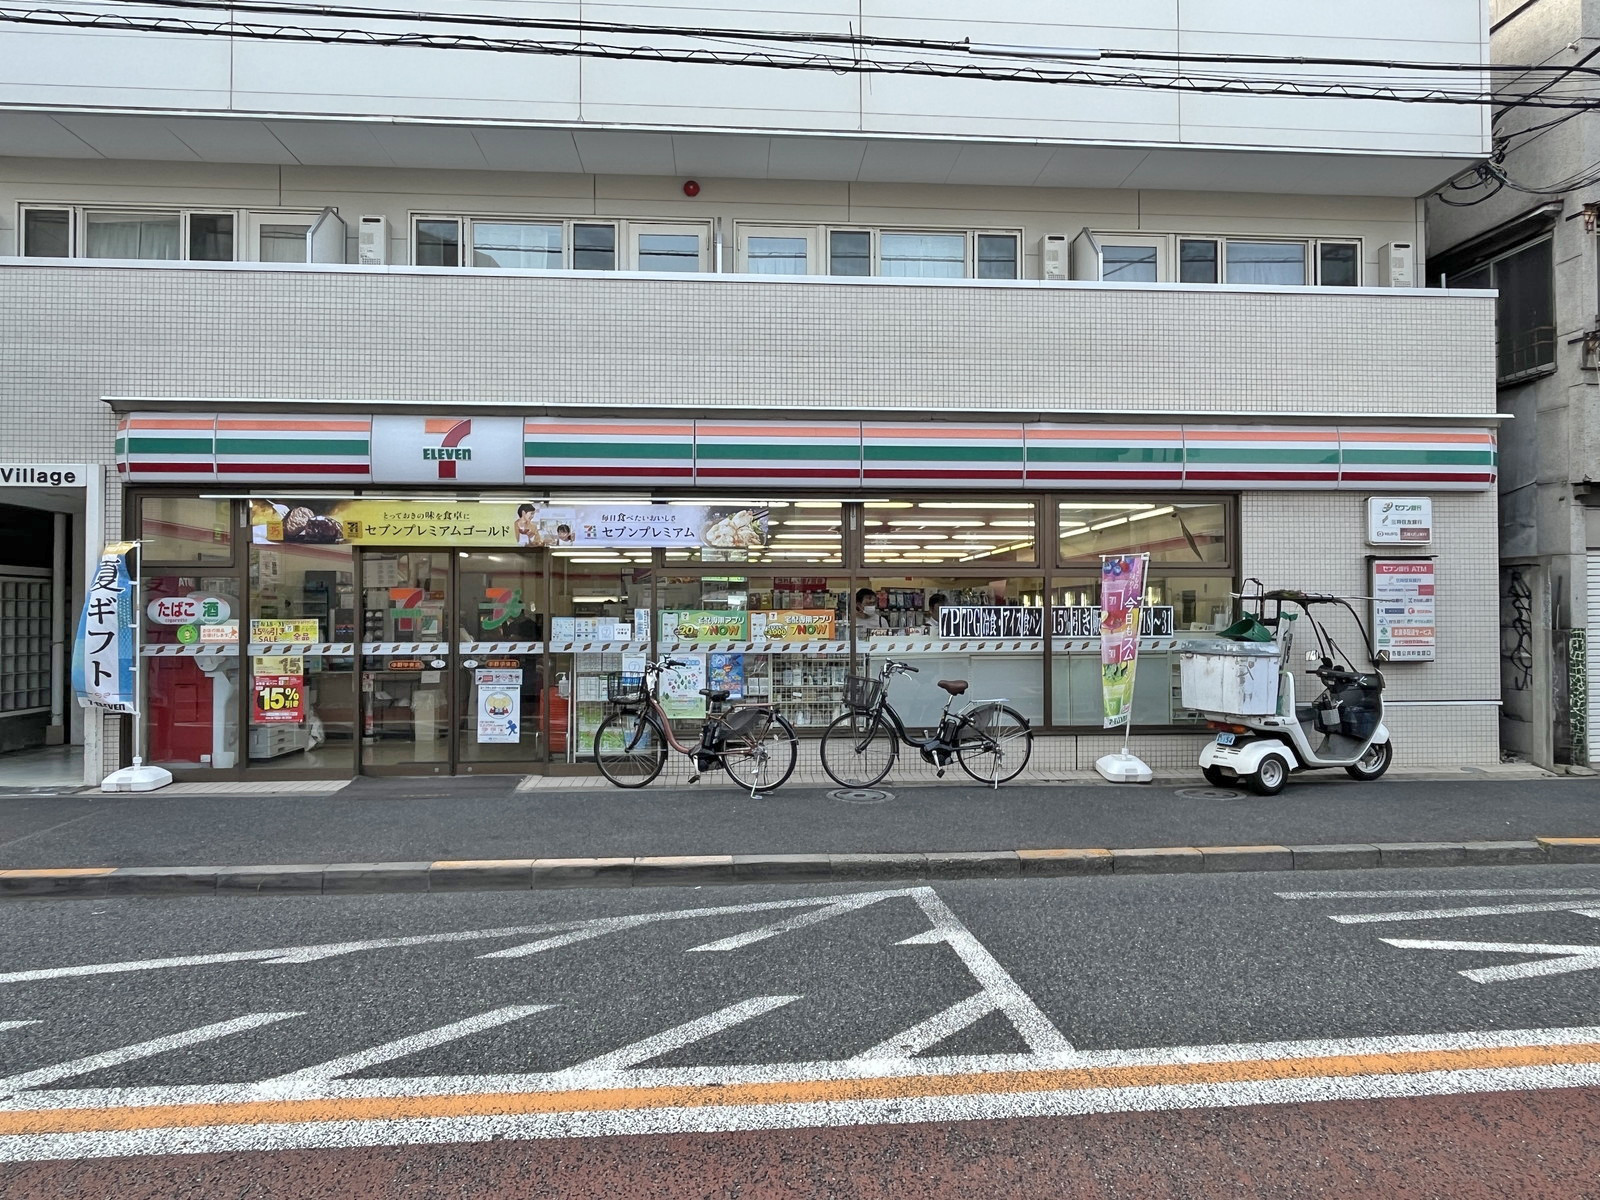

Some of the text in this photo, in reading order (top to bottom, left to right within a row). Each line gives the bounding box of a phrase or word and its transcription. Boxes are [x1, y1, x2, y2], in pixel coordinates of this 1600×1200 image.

[0, 467, 76, 486] Village
[383, 511, 470, 521] とっておきの味を食卓に
[364, 524, 511, 538] セブンプレミアムゴールド
[601, 526, 696, 539] セブンプレミアム
[1411, 565, 1427, 573] ATM
[157, 601, 196, 618] たばこ
[202, 601, 219, 618] 酒
[87, 559, 125, 688] 夏ギフト
[790, 624, 828, 636] 7NOW
[702, 625, 740, 636] 7NOW
